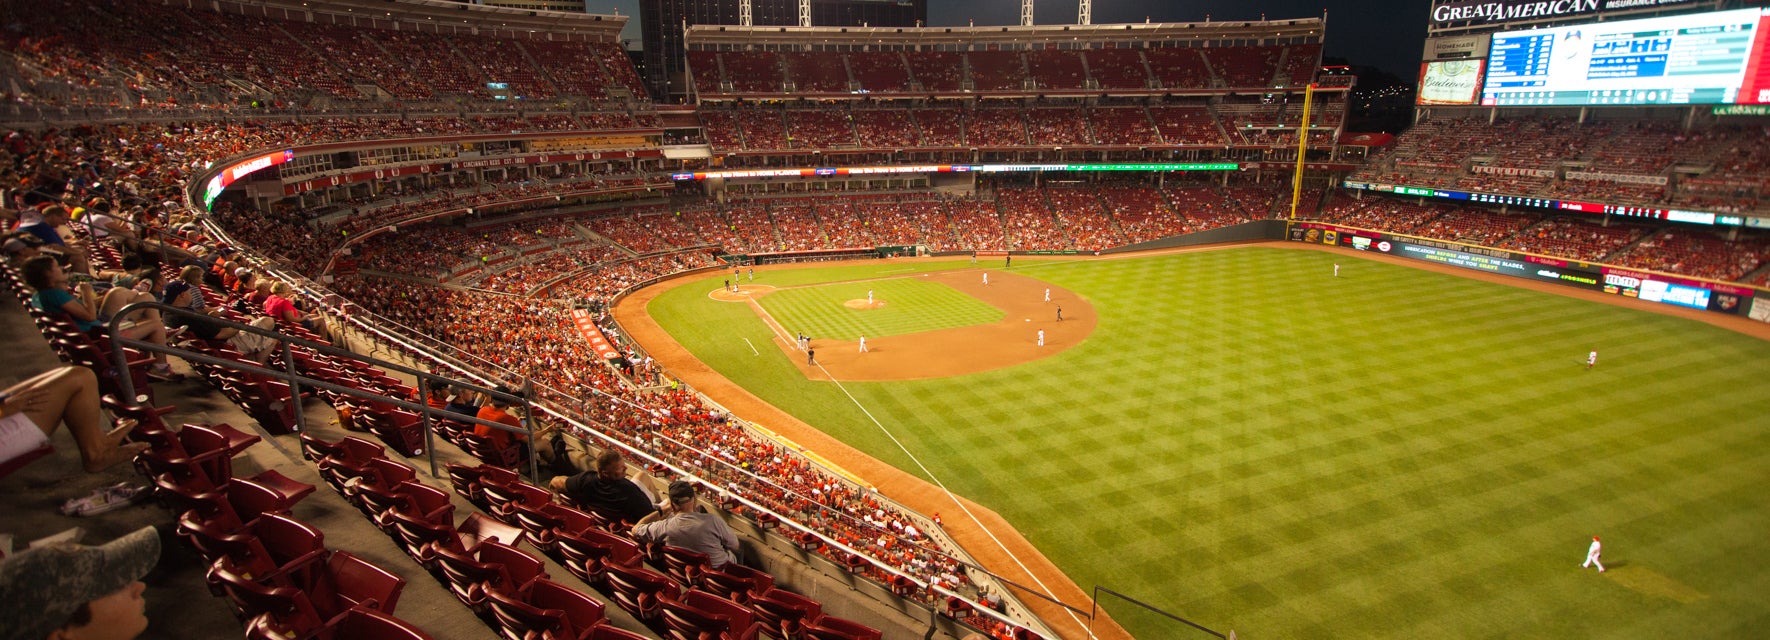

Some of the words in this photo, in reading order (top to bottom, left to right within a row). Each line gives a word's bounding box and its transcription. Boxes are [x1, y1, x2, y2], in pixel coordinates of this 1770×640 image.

[1606, 0, 1657, 8] INSURANCE
[1436, 42, 1474, 50] HOMEMADE
[463, 160, 488, 168] CINCINNATI
[1404, 246, 1436, 255] LUBRICATION
[1436, 250, 1457, 259] BEFORE
[1471, 256, 1489, 264] AFTER
[1426, 254, 1447, 262] SHIELDS
[1448, 258, 1464, 266] WHILE
[1478, 263, 1499, 271] SHAVE
[1627, 270, 1650, 280] LEAGUE
